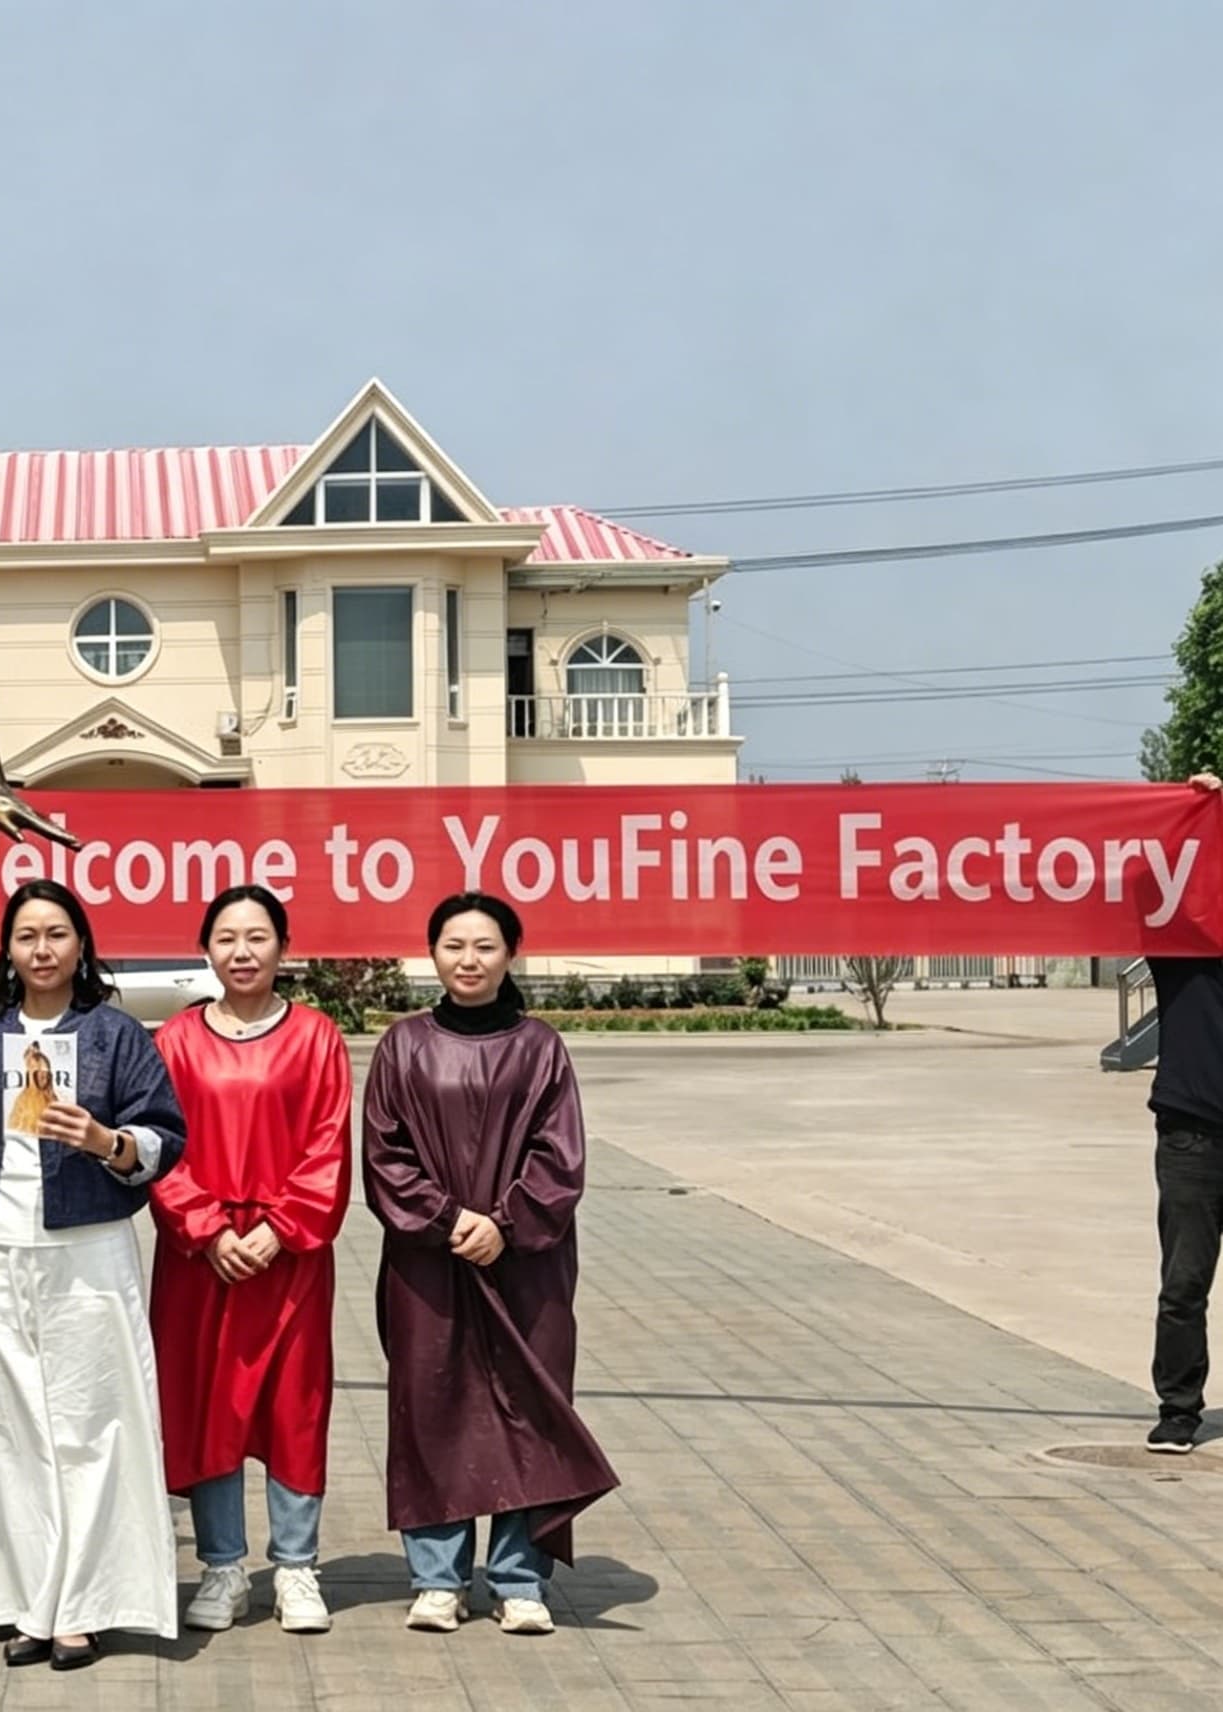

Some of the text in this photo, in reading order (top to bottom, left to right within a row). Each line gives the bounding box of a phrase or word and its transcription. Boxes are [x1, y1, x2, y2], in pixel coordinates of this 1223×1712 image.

[325, 823, 415, 904] to
[442, 811, 803, 902] YouFine
[839, 813, 1201, 928] Factory
[3, 1070, 73, 1090] DIOR
